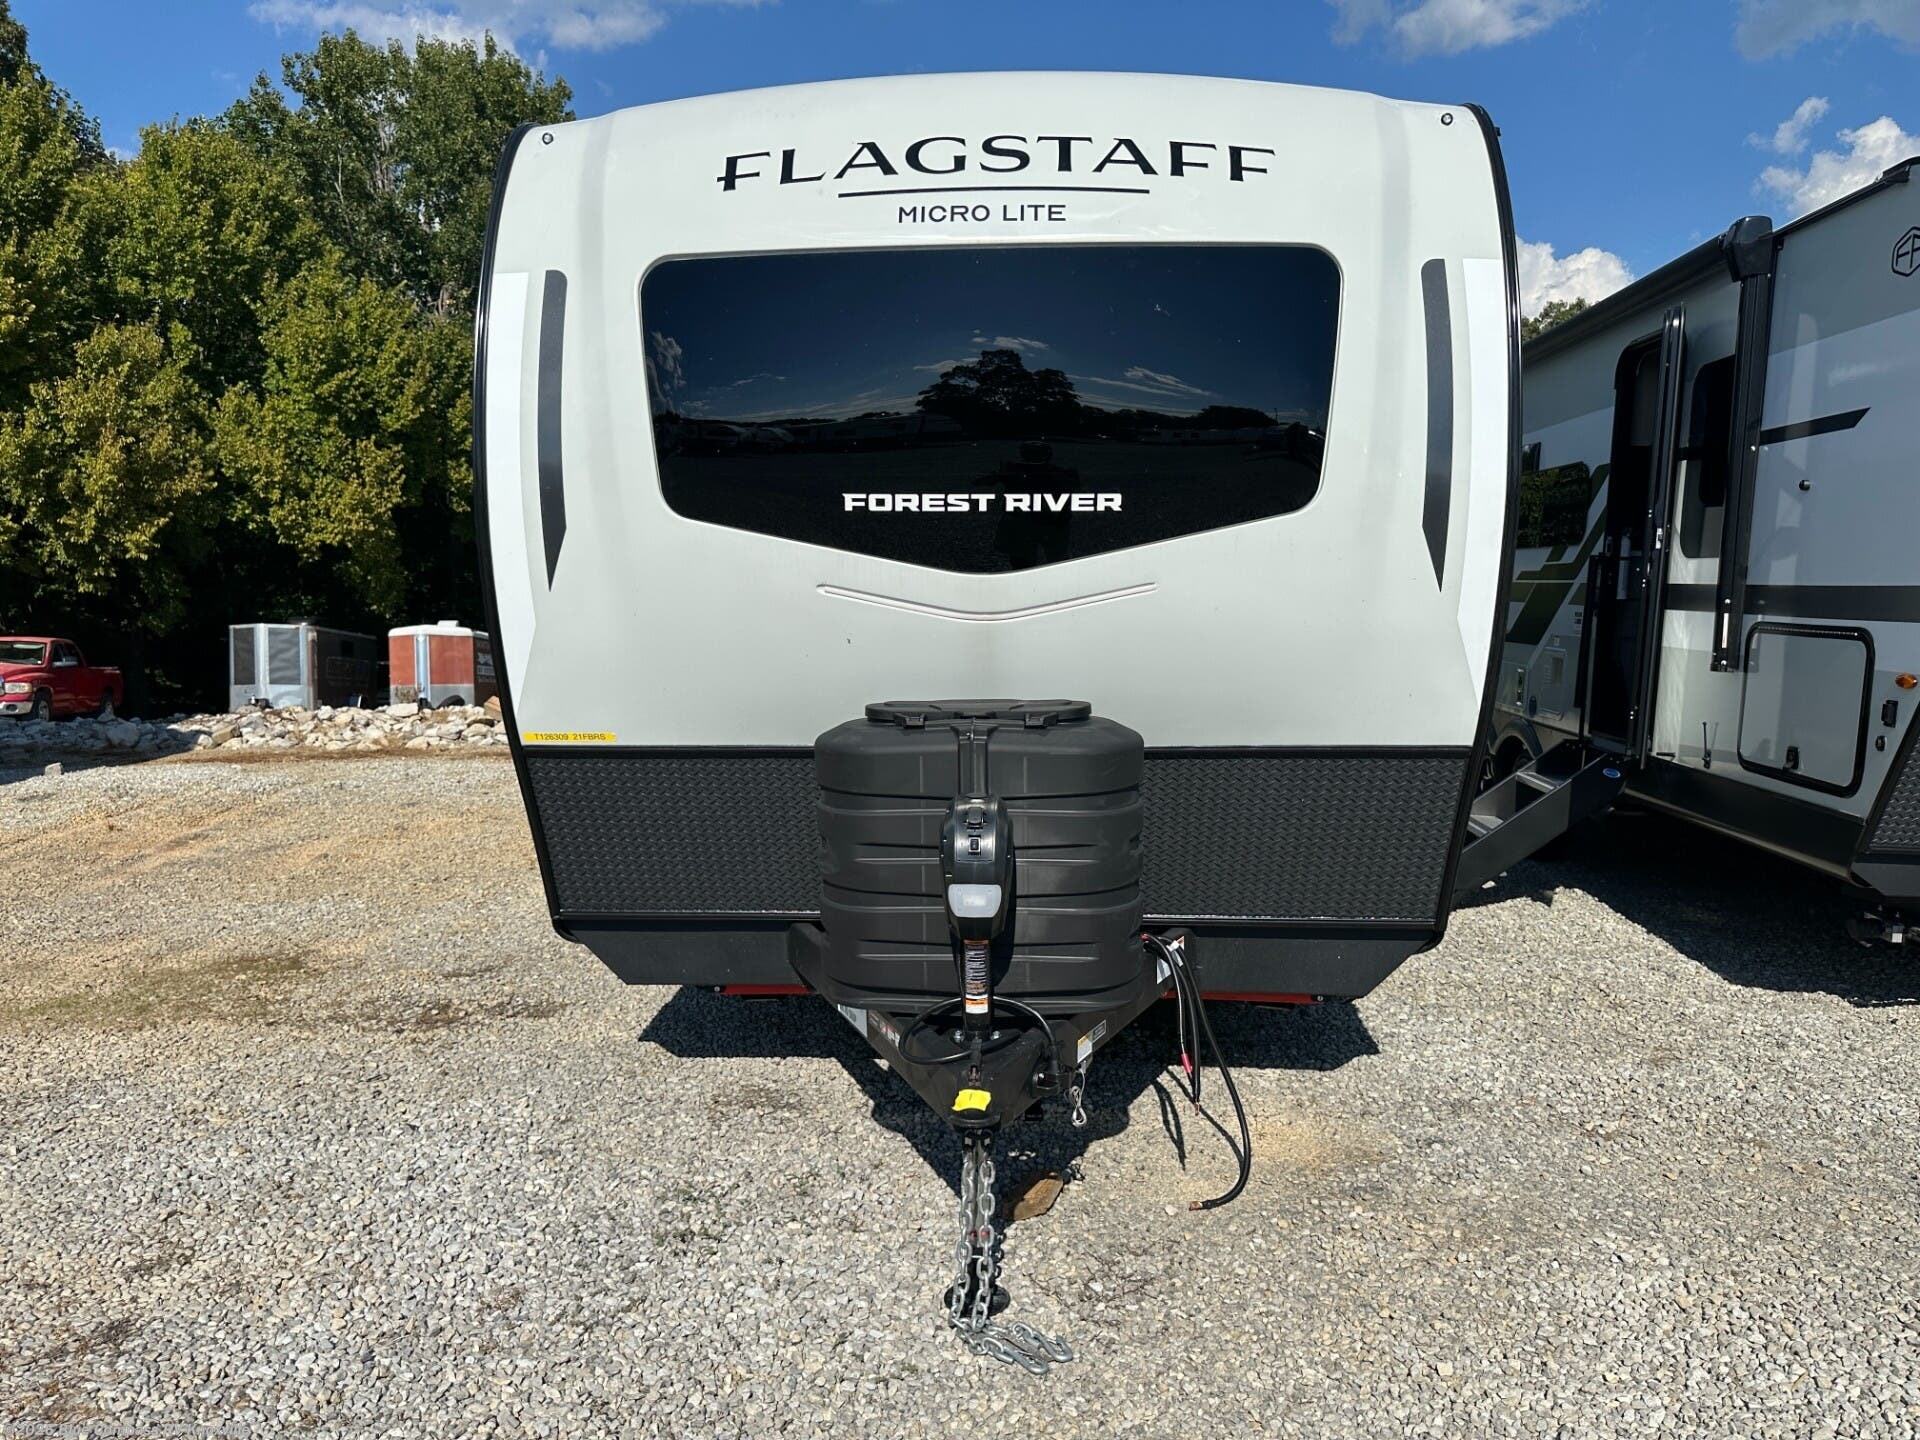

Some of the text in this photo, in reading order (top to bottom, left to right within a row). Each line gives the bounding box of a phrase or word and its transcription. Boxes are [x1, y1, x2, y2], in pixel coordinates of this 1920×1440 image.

[717, 135, 1276, 192] FLAGSTAFF
[899, 204, 1066, 224] MICRO LITE
[842, 493, 1122, 512] FOREST RIVER
[534, 733, 606, 741] T126309 21FBRS
